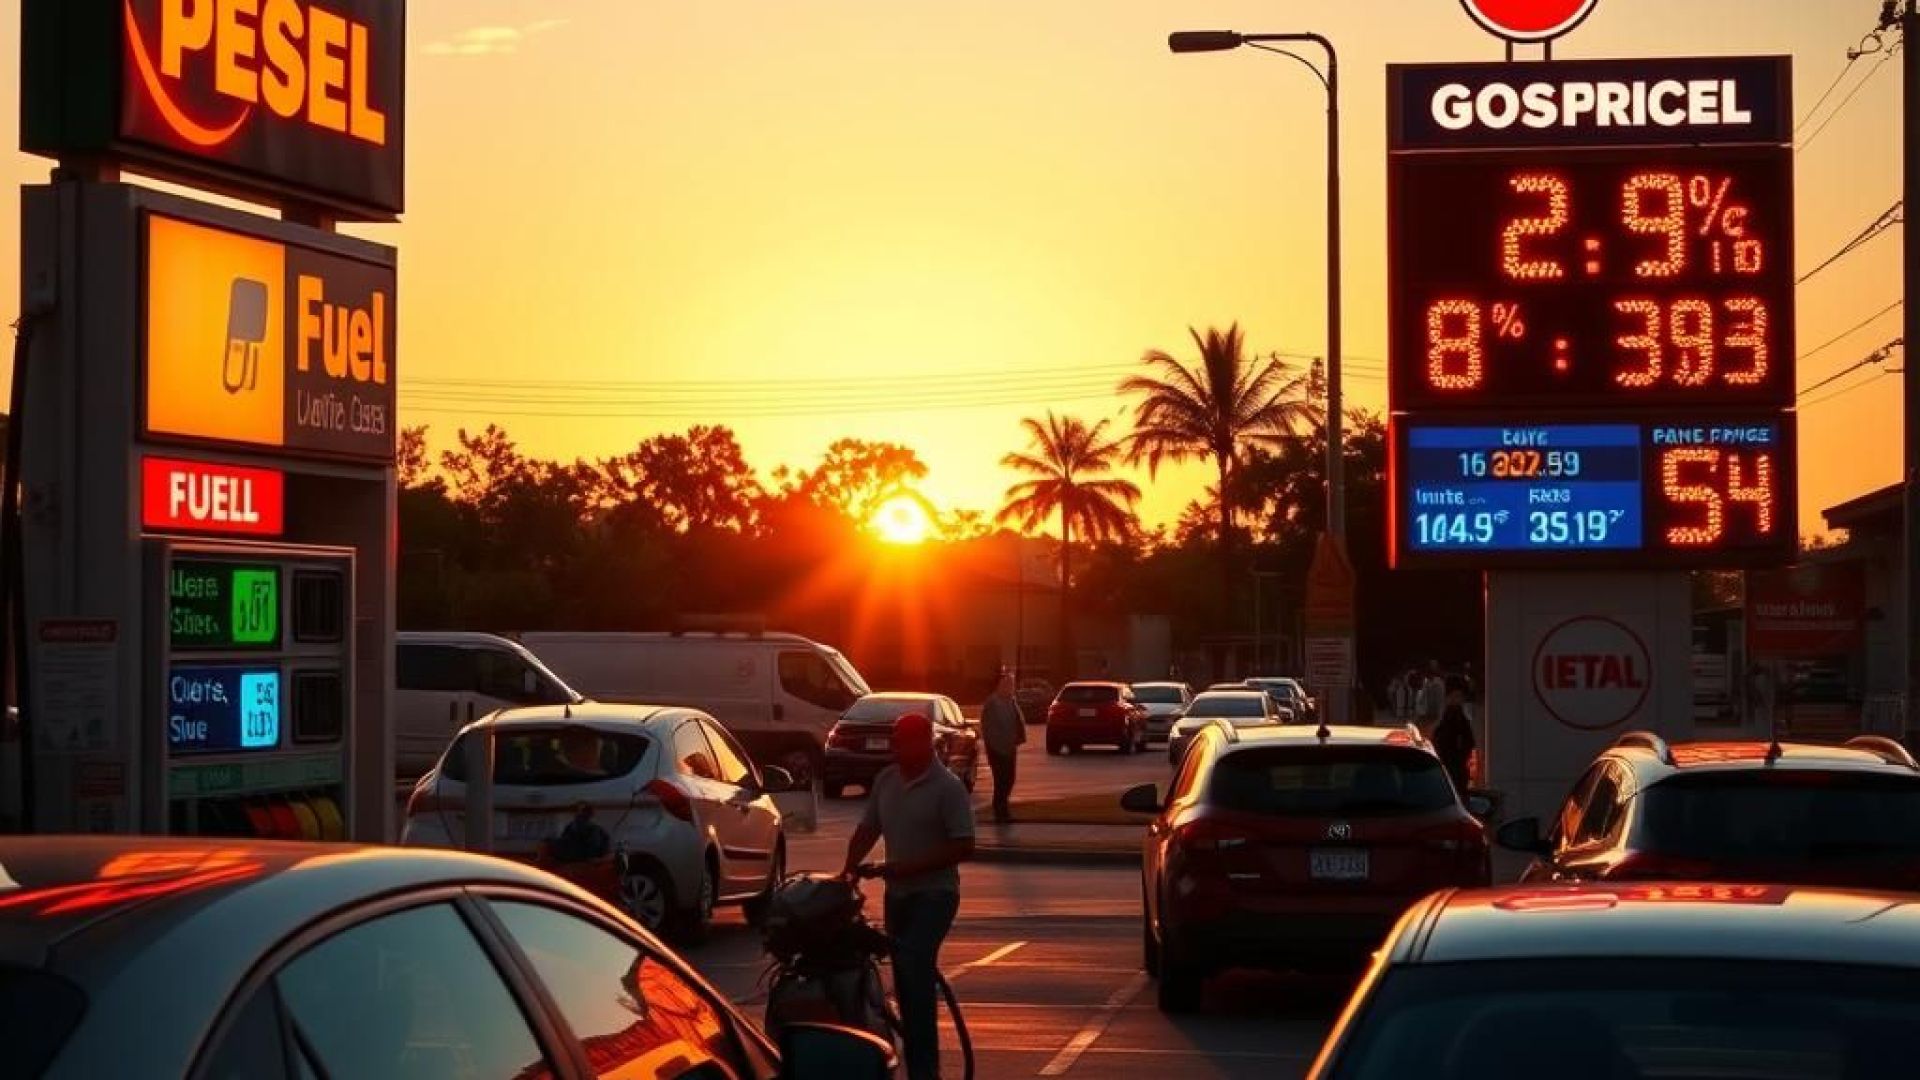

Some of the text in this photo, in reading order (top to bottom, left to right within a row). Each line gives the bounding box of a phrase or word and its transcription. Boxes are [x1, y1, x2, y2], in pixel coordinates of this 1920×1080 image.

[160, 0, 385, 146] PESEL
[1431, 79, 1752, 129] GOSPRICEL
[297, 274, 387, 386] Fuel
[169, 471, 260, 523] FUELL
